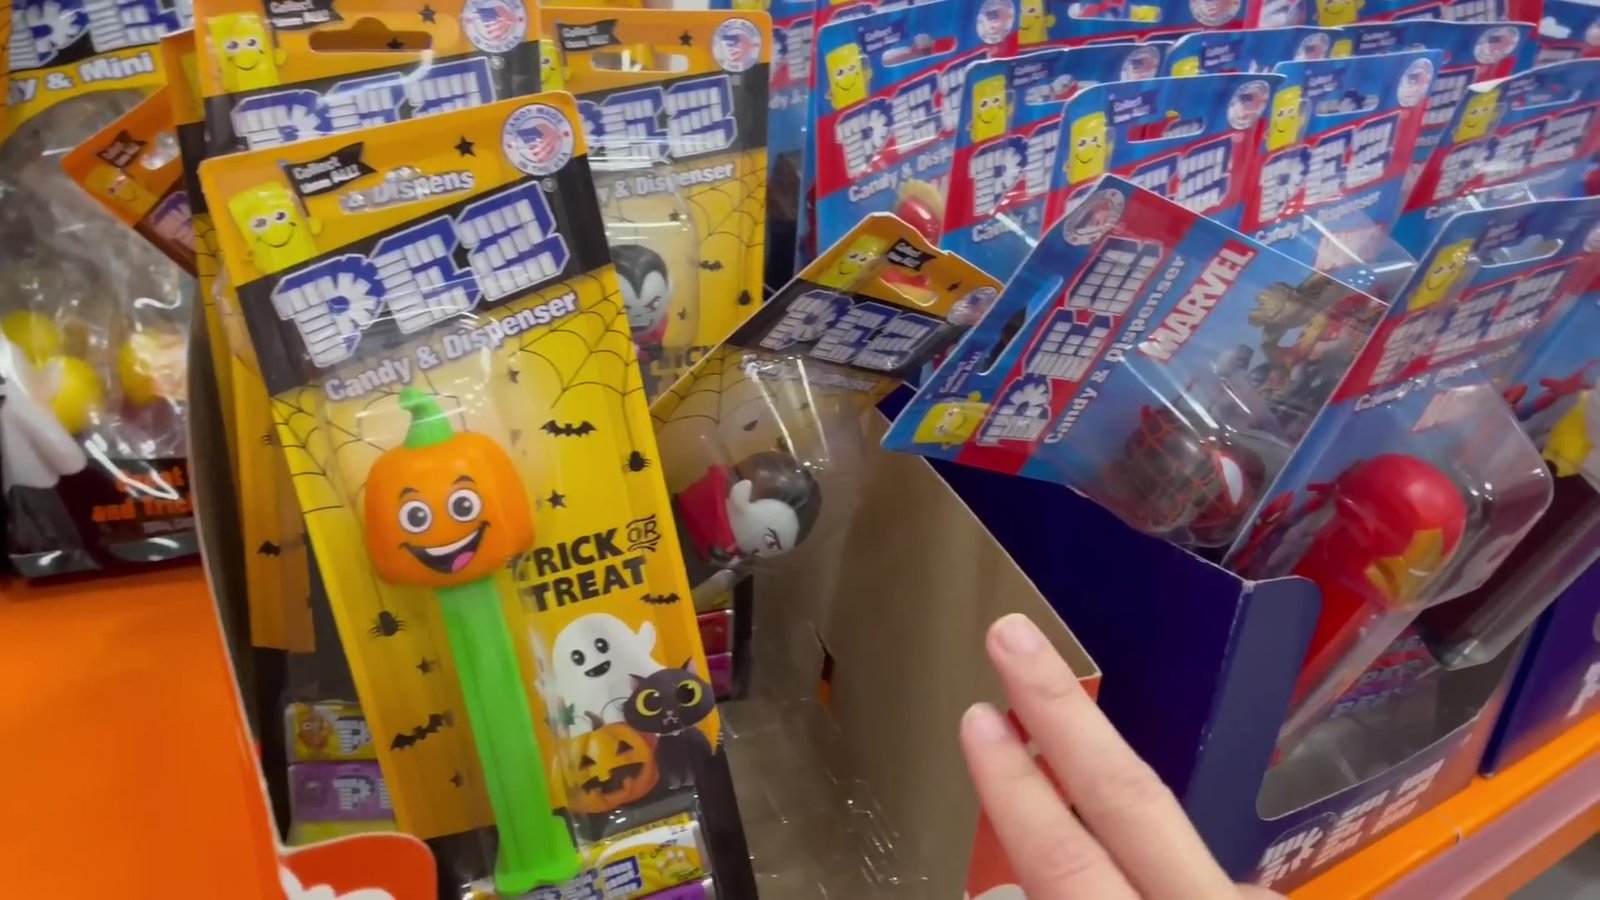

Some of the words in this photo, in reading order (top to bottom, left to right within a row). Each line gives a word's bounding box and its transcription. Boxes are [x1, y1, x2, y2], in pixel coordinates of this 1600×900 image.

[46, 73, 72, 90] &
[79, 52, 155, 82] Mini
[270, 179, 571, 369] PEZ
[1139, 242, 1255, 362] MARVEL
[326, 356, 410, 401] Candy
[416, 345, 440, 370] &
[442, 291, 577, 360] Dispenser
[759, 289, 946, 372] PEZ
[507, 527, 625, 582] TRICK
[627, 519, 659, 545] OR
[519, 556, 646, 613] TREAT
